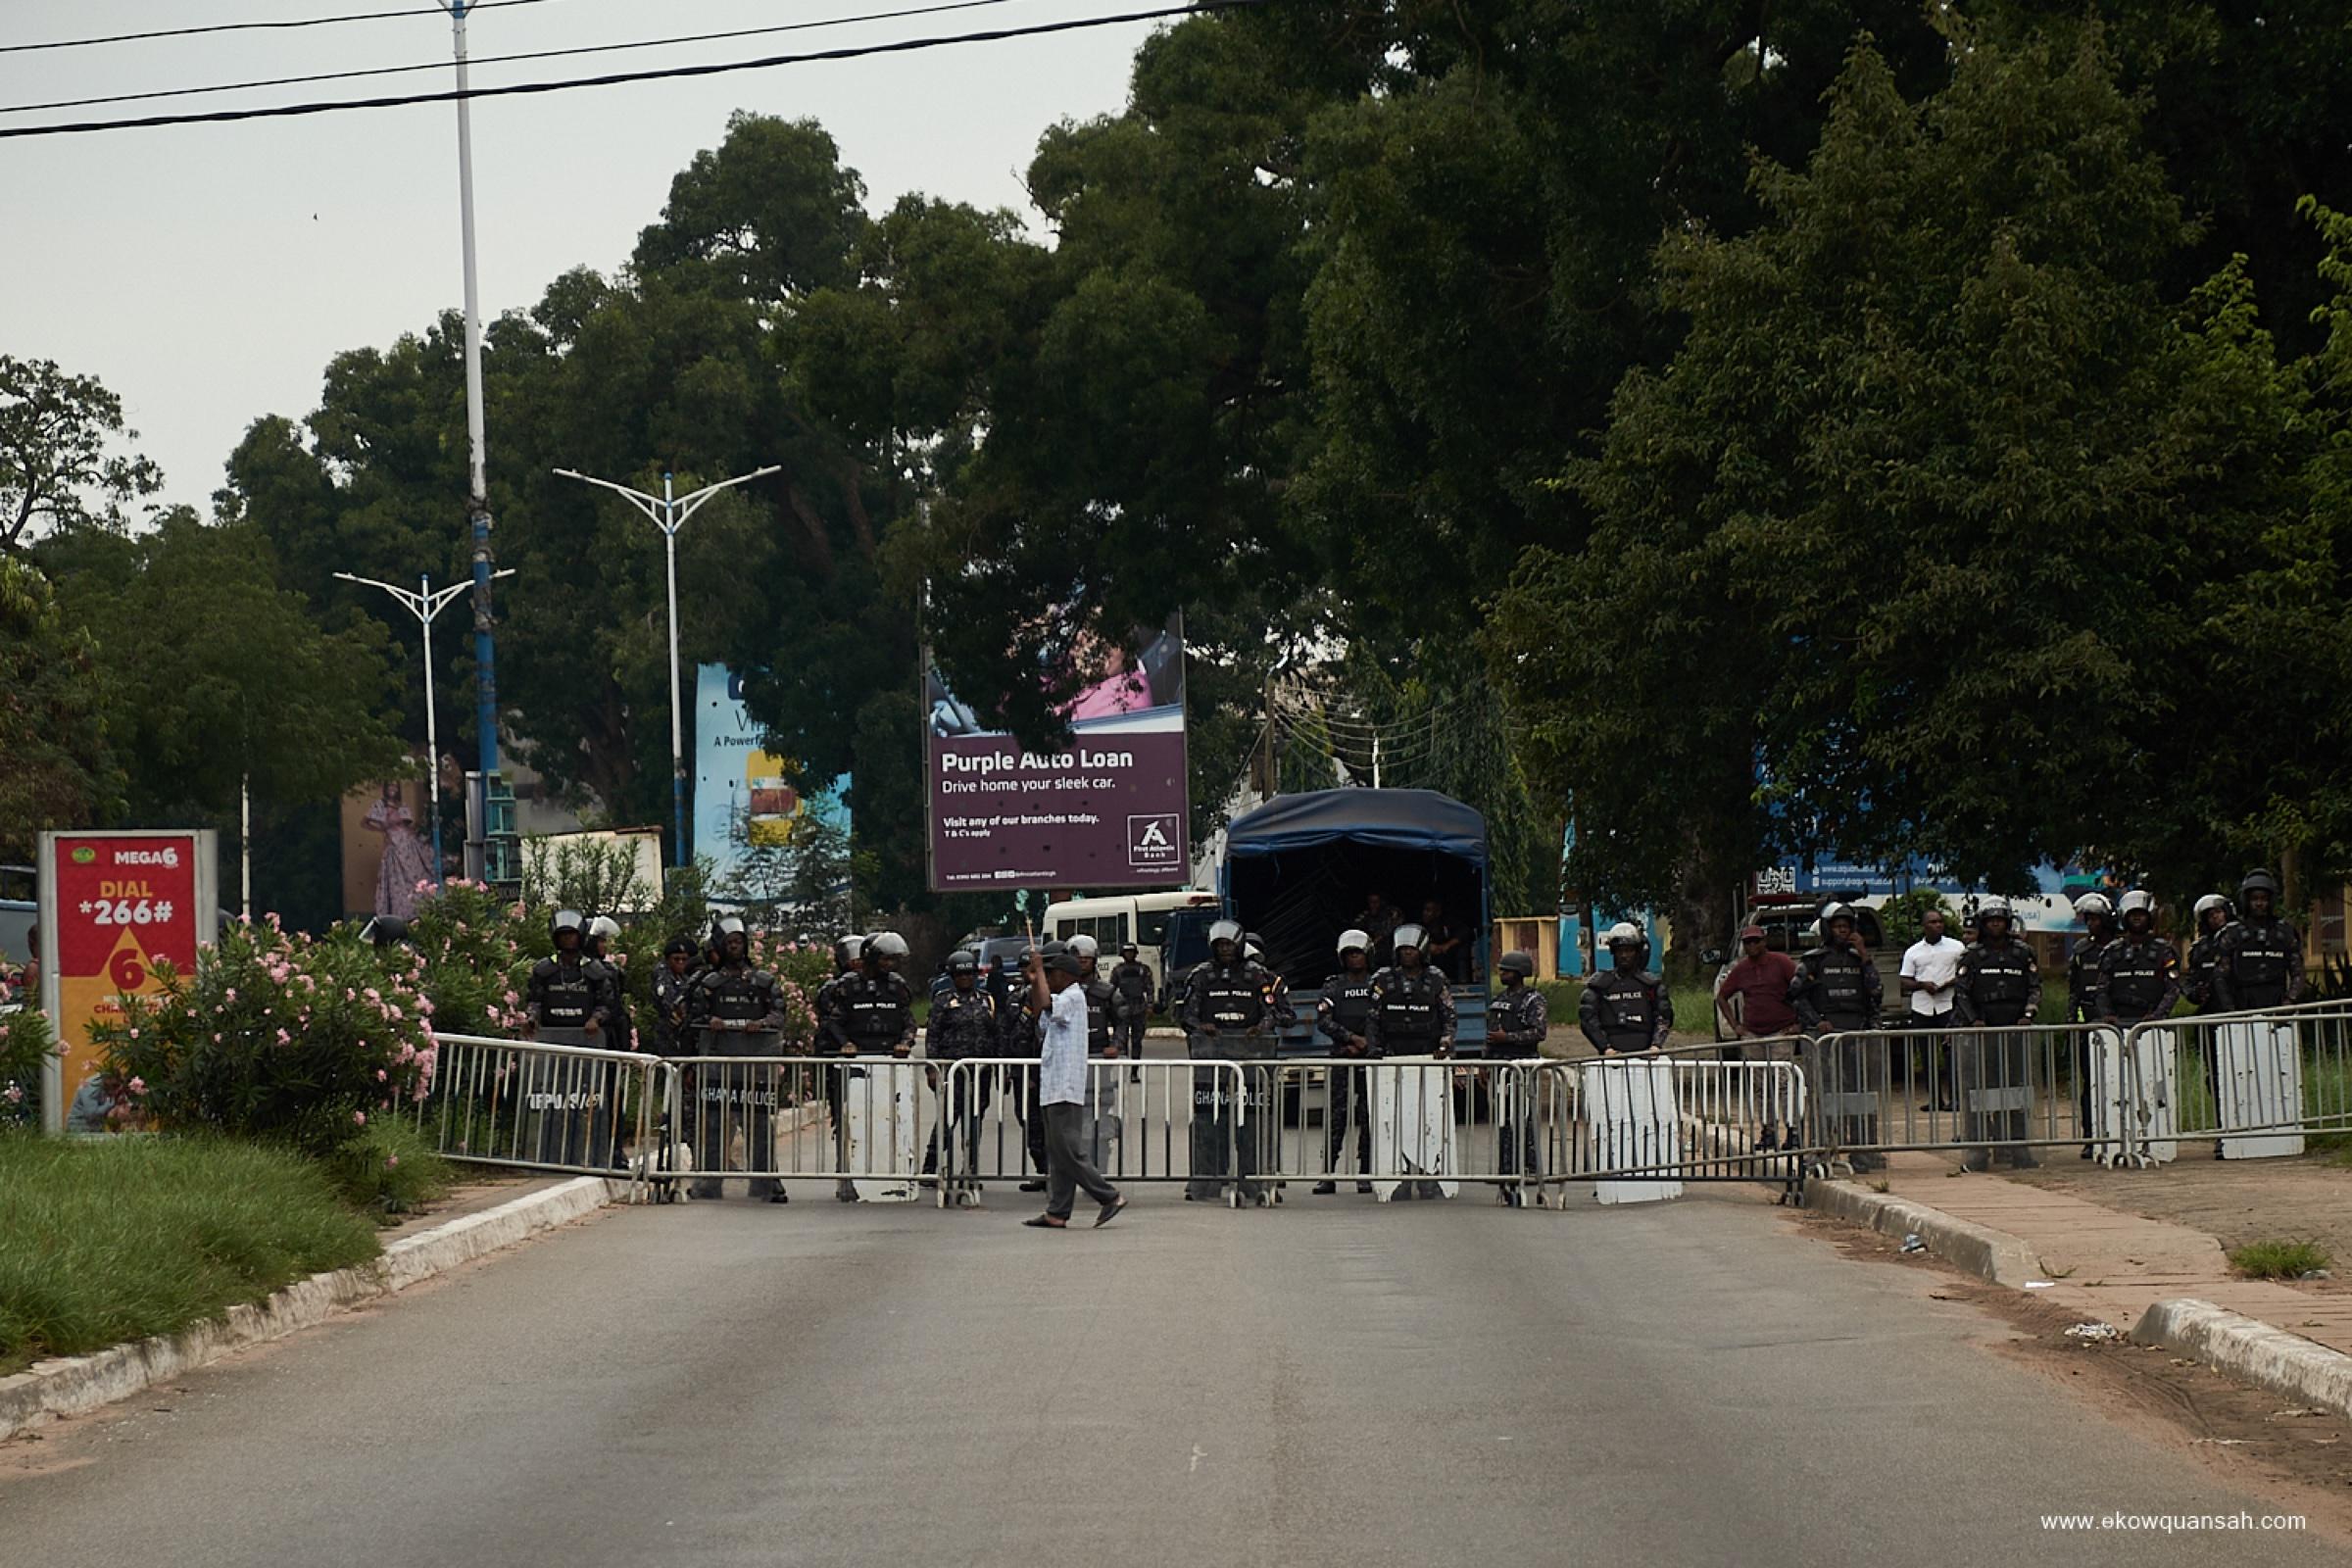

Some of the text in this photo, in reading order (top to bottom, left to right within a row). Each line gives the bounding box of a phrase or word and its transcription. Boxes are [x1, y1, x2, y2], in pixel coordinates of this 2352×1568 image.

[713, 734, 764, 747] A Powerf
[942, 749, 1133, 775] Purple Auto Loan
[942, 776, 1115, 793] Drive home your sleek car.
[944, 812, 1100, 828] Visit any of our branches today.
[100, 880, 154, 898] DIAL
[110, 948, 145, 990] 6
[1345, 989, 1369, 998] POLIC
